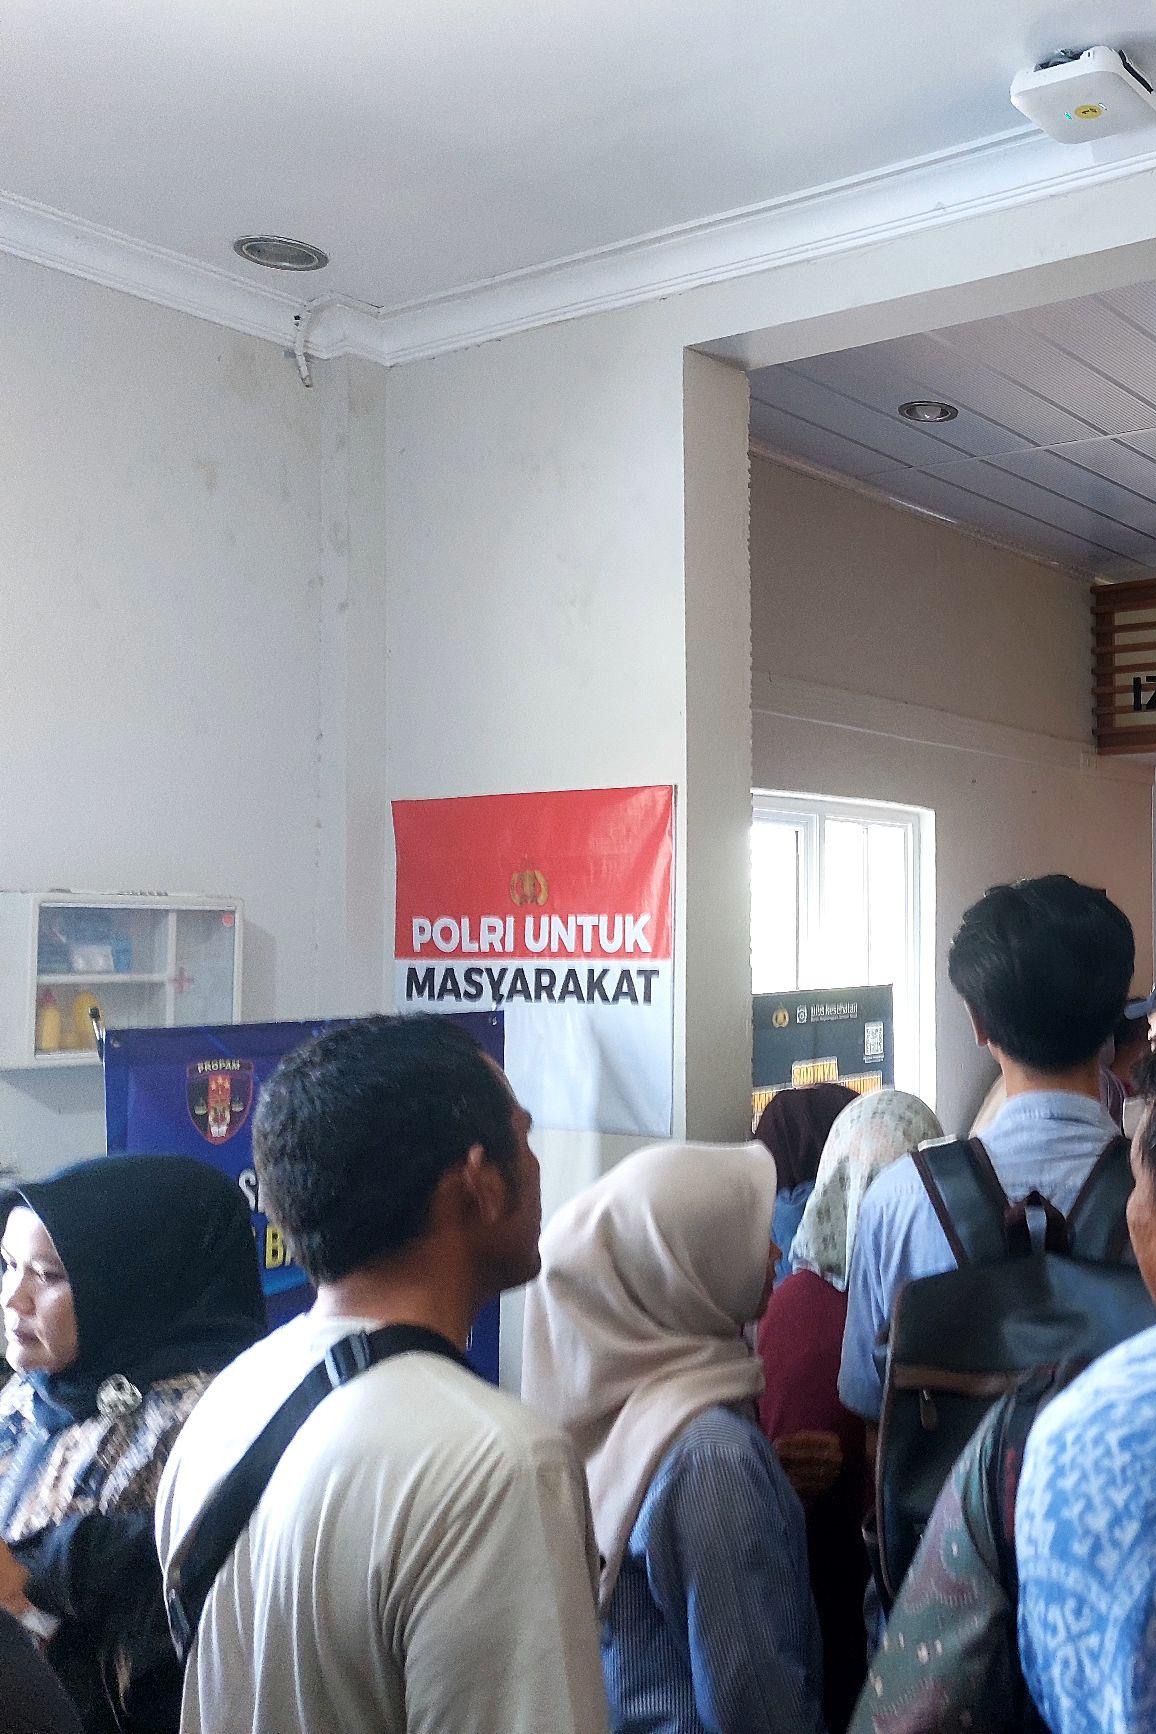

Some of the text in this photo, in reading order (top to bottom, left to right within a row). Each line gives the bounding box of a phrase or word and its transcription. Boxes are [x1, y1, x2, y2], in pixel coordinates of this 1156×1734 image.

[411, 913, 653, 954] POLRI UNTUK
[405, 966, 660, 1006] MASYARAKAT
